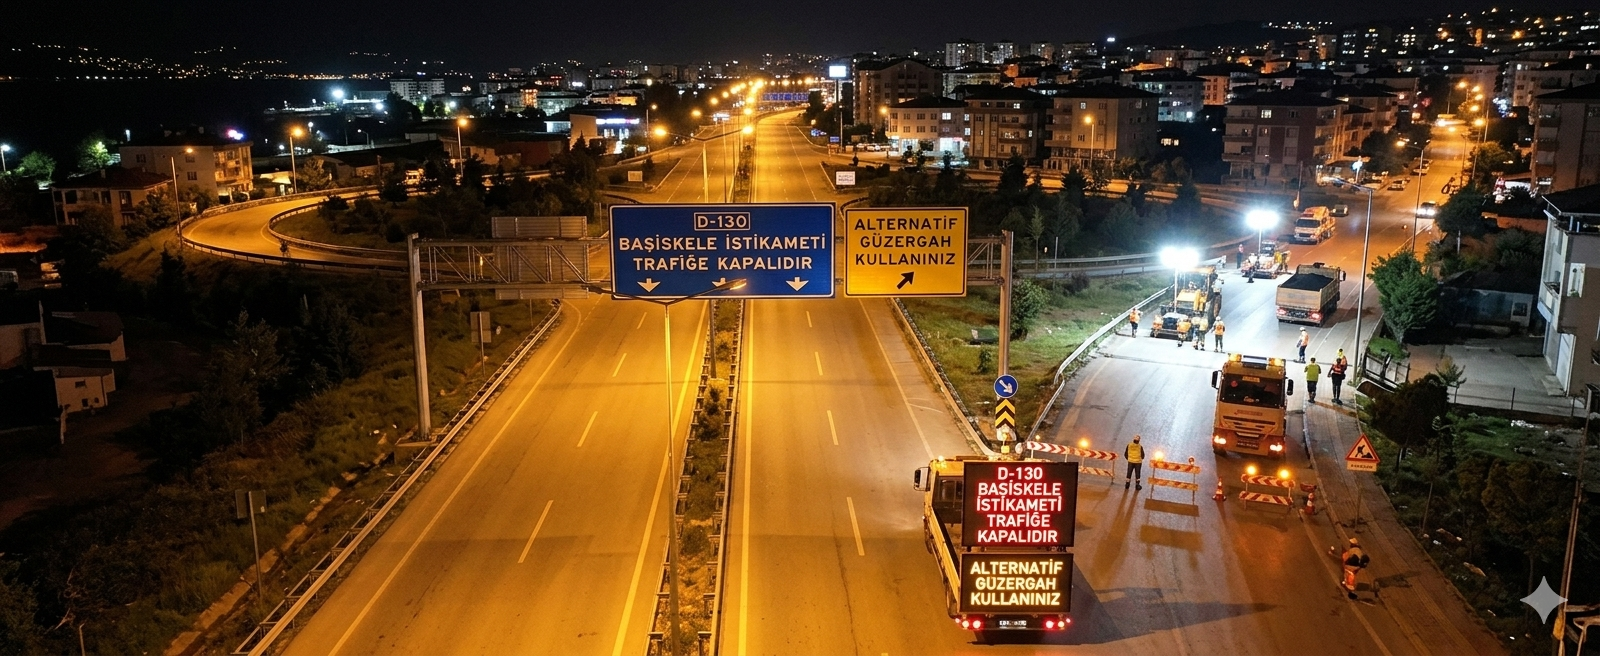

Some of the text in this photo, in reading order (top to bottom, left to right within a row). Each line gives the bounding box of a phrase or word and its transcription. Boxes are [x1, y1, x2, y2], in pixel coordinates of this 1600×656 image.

[697, 215, 747, 228] D-130
[854, 215, 958, 230] ALTERNATİF
[619, 233, 826, 252] BAŞİSKELE İSTİKAMETİ
[860, 233, 951, 248] GÜZERGAH
[633, 255, 812, 271] TRAFİĞE KAPALIDIR
[855, 253, 956, 265] KULLANINIZ
[997, 467, 1043, 480] D-130
[976, 496, 1062, 512] İSTİKAMETİ
[977, 530, 1058, 543] KAPALIDIR
[970, 558, 1063, 575] ALTERNATİF
[970, 592, 1061, 605] KULLANINIZ
